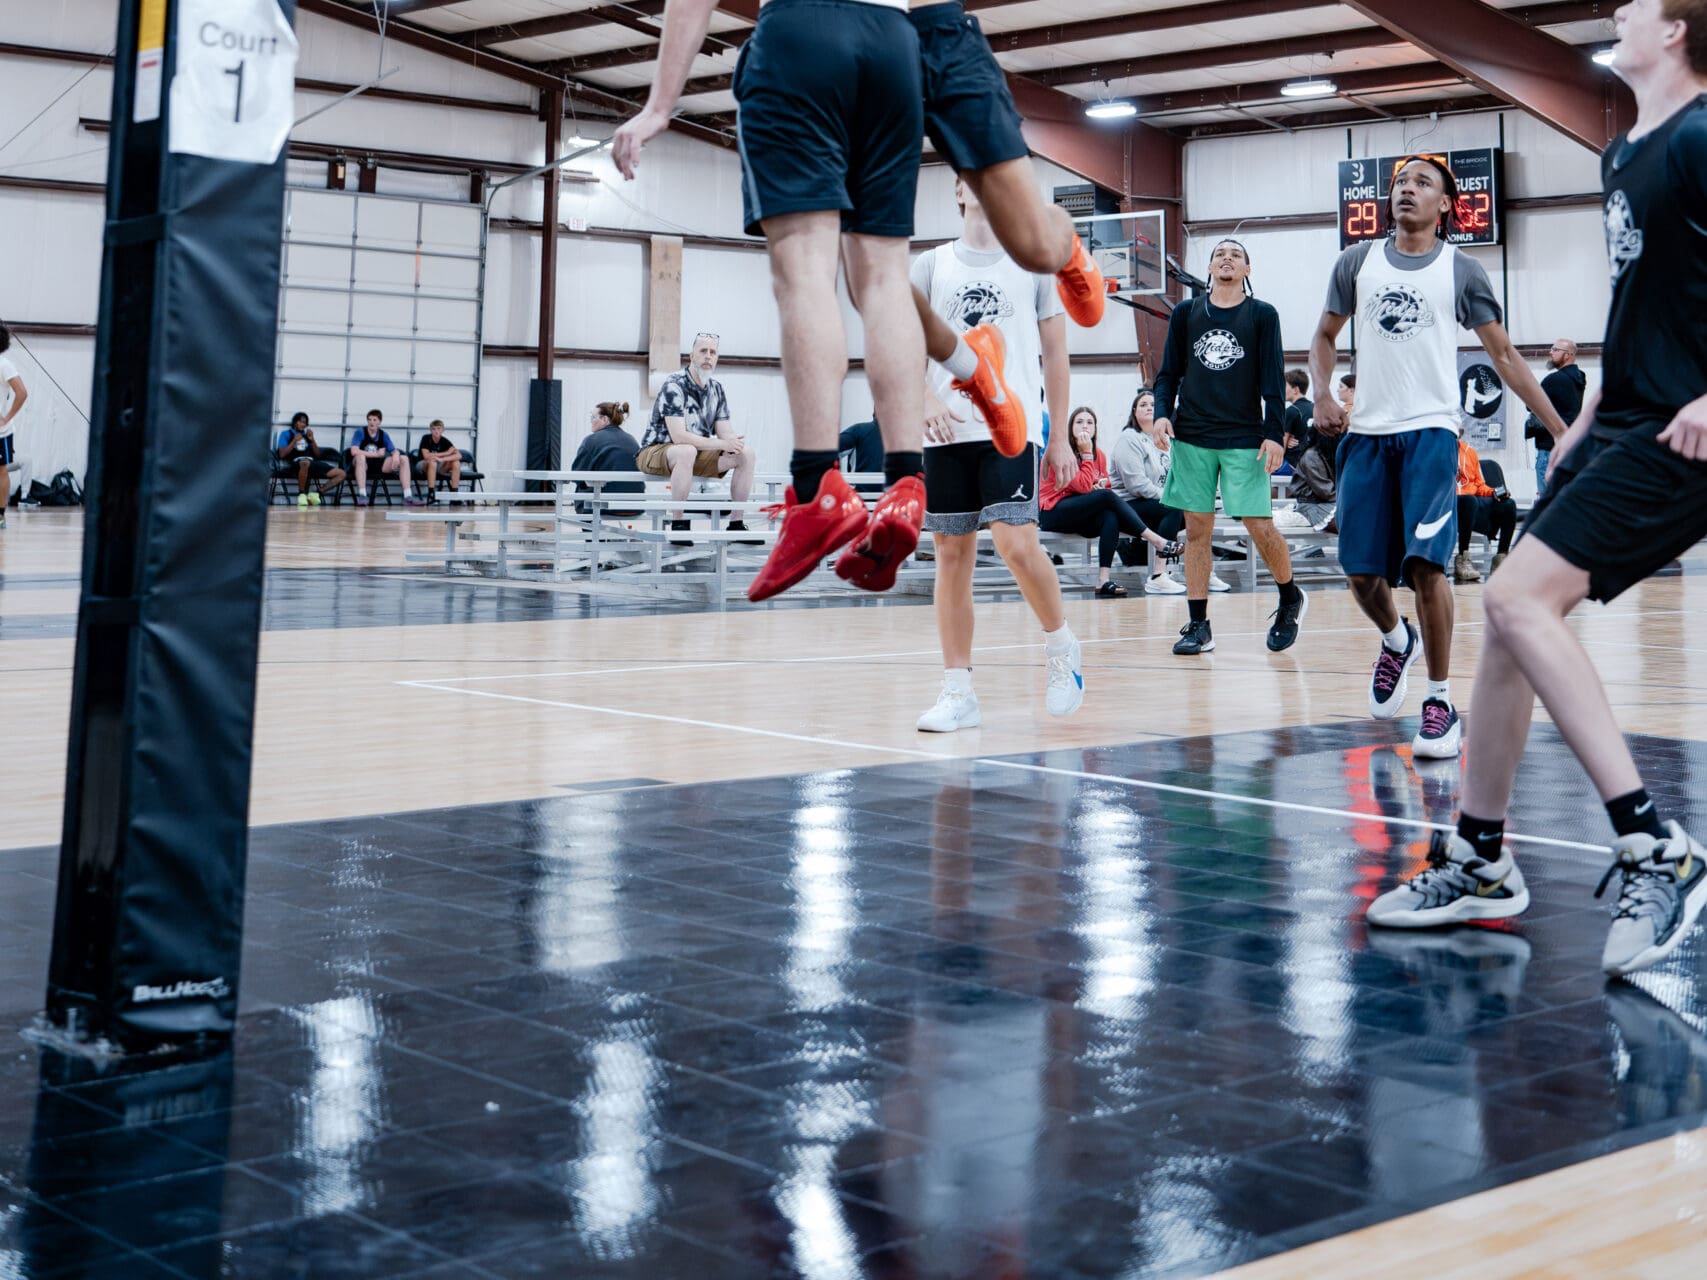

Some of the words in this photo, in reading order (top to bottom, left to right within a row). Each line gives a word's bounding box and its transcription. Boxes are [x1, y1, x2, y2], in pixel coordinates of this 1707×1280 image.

[199, 21, 278, 55] Court
[224, 60, 245, 123] 1
[1343, 186, 1375, 200] HOME
[1347, 202, 1377, 236] 29
[1449, 233, 1474, 242] ONUS
[1377, 328, 1414, 340] SOUTH
[1204, 360, 1231, 369] SOUTH
